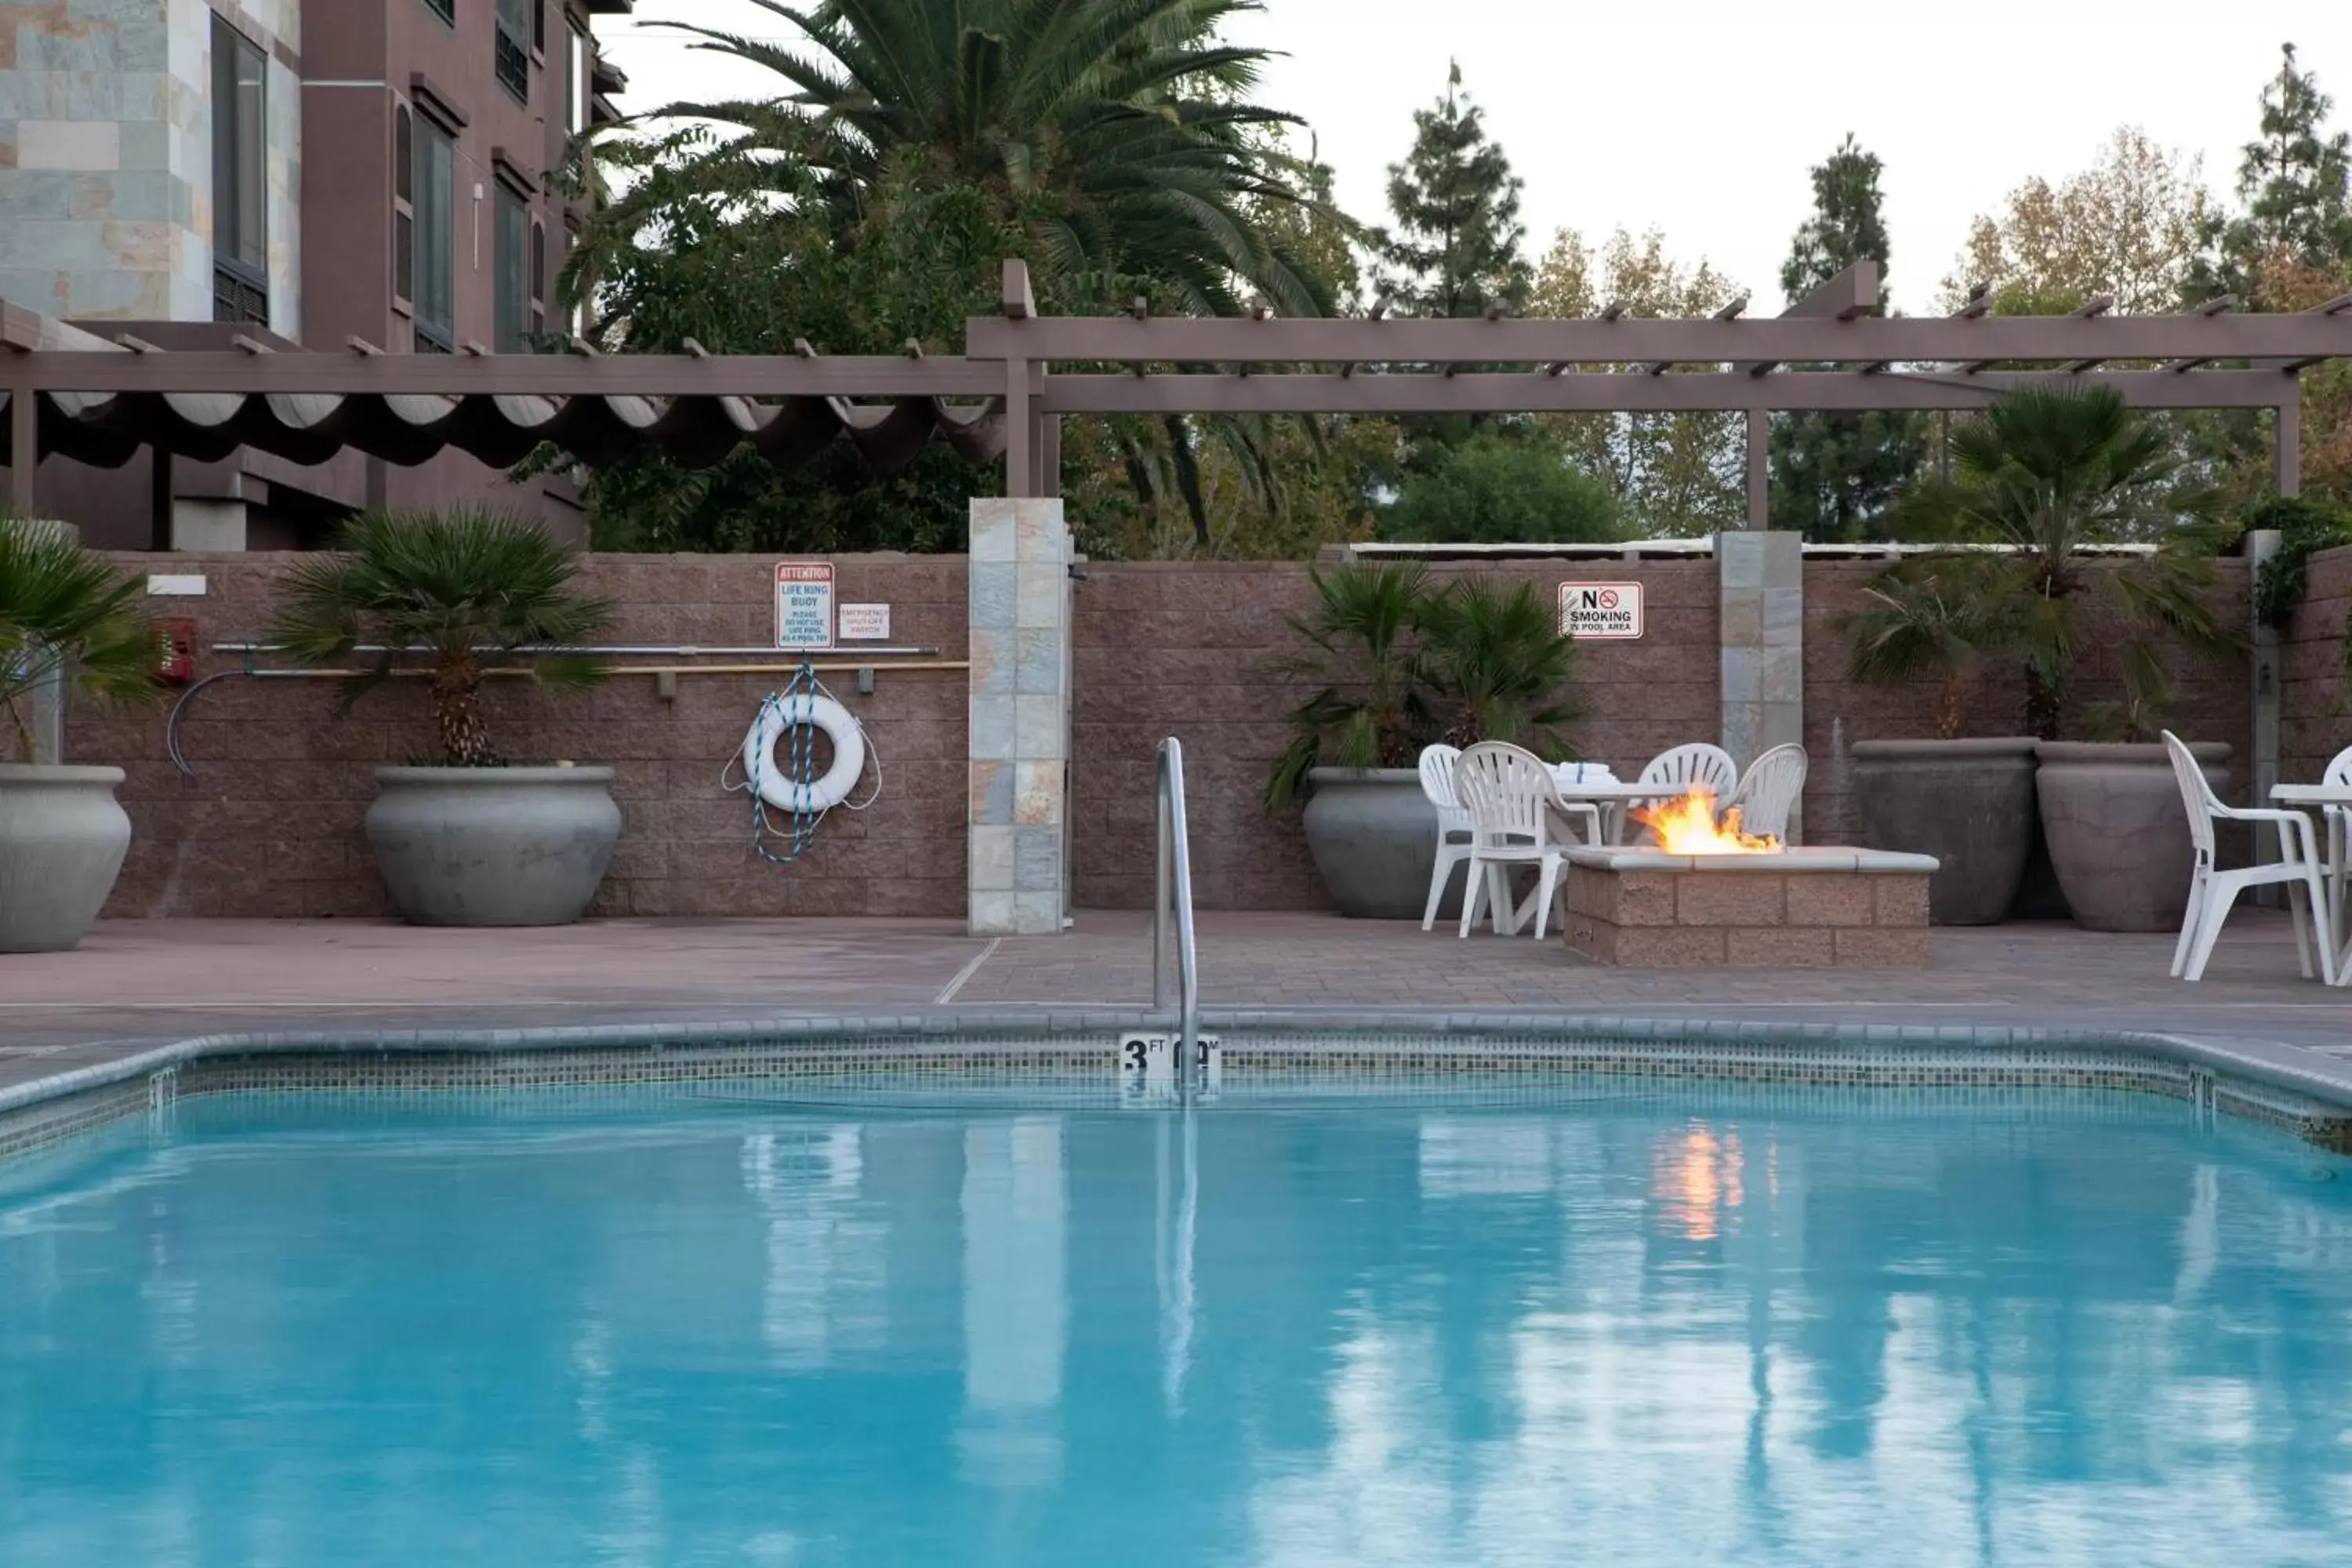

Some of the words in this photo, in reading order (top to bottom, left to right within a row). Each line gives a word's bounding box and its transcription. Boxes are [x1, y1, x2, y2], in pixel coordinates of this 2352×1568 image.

[780, 568, 830, 579] ATTENTION
[782, 586, 801, 594] LIFE
[804, 586, 828, 594] RING
[791, 597, 818, 607] BUOY
[1570, 611, 1632, 622] SMOKING
